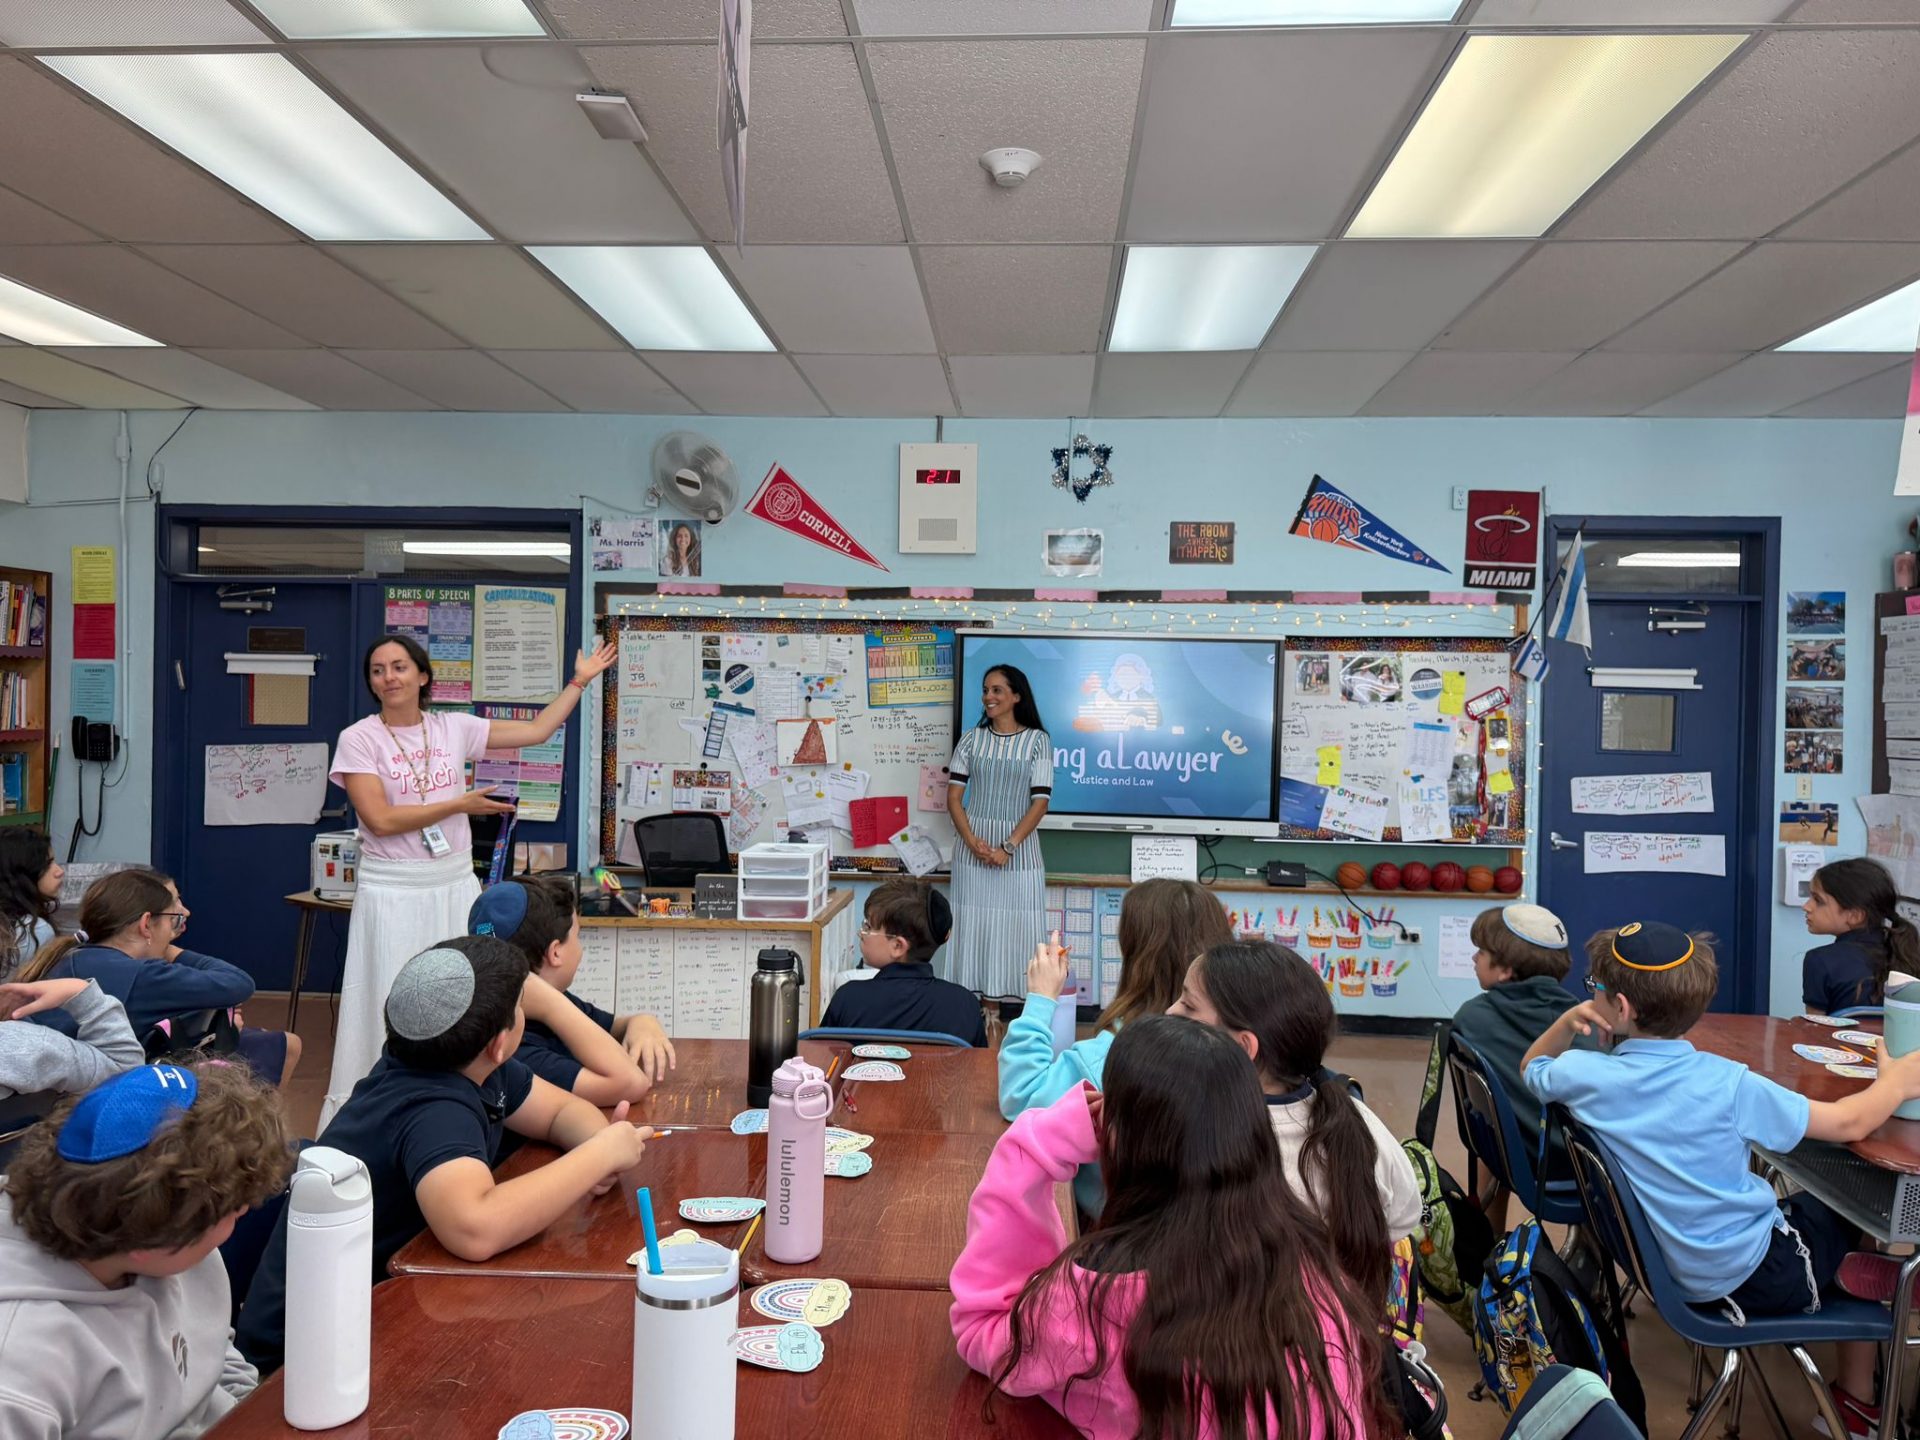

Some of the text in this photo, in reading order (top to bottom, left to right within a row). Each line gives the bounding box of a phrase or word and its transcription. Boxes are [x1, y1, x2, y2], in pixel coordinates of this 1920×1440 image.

[1306, 494, 1360, 538] KNICKS
[798, 510, 851, 553] CORNELL
[1177, 524, 1228, 538] THE ROOM
[1374, 530, 1404, 549] New York
[600, 538, 645, 547] Ms. Harris
[1186, 544, 1228, 561] HAPPENS
[1468, 570, 1531, 587] MIAMI
[389, 588, 470, 601] 8 PARTS OF SPEECH
[485, 706, 541, 720] PUNCTUAT
[390, 762, 457, 795] Teach
[1072, 775, 1154, 786] Justice and Law
[779, 1139, 797, 1226] lululemon
